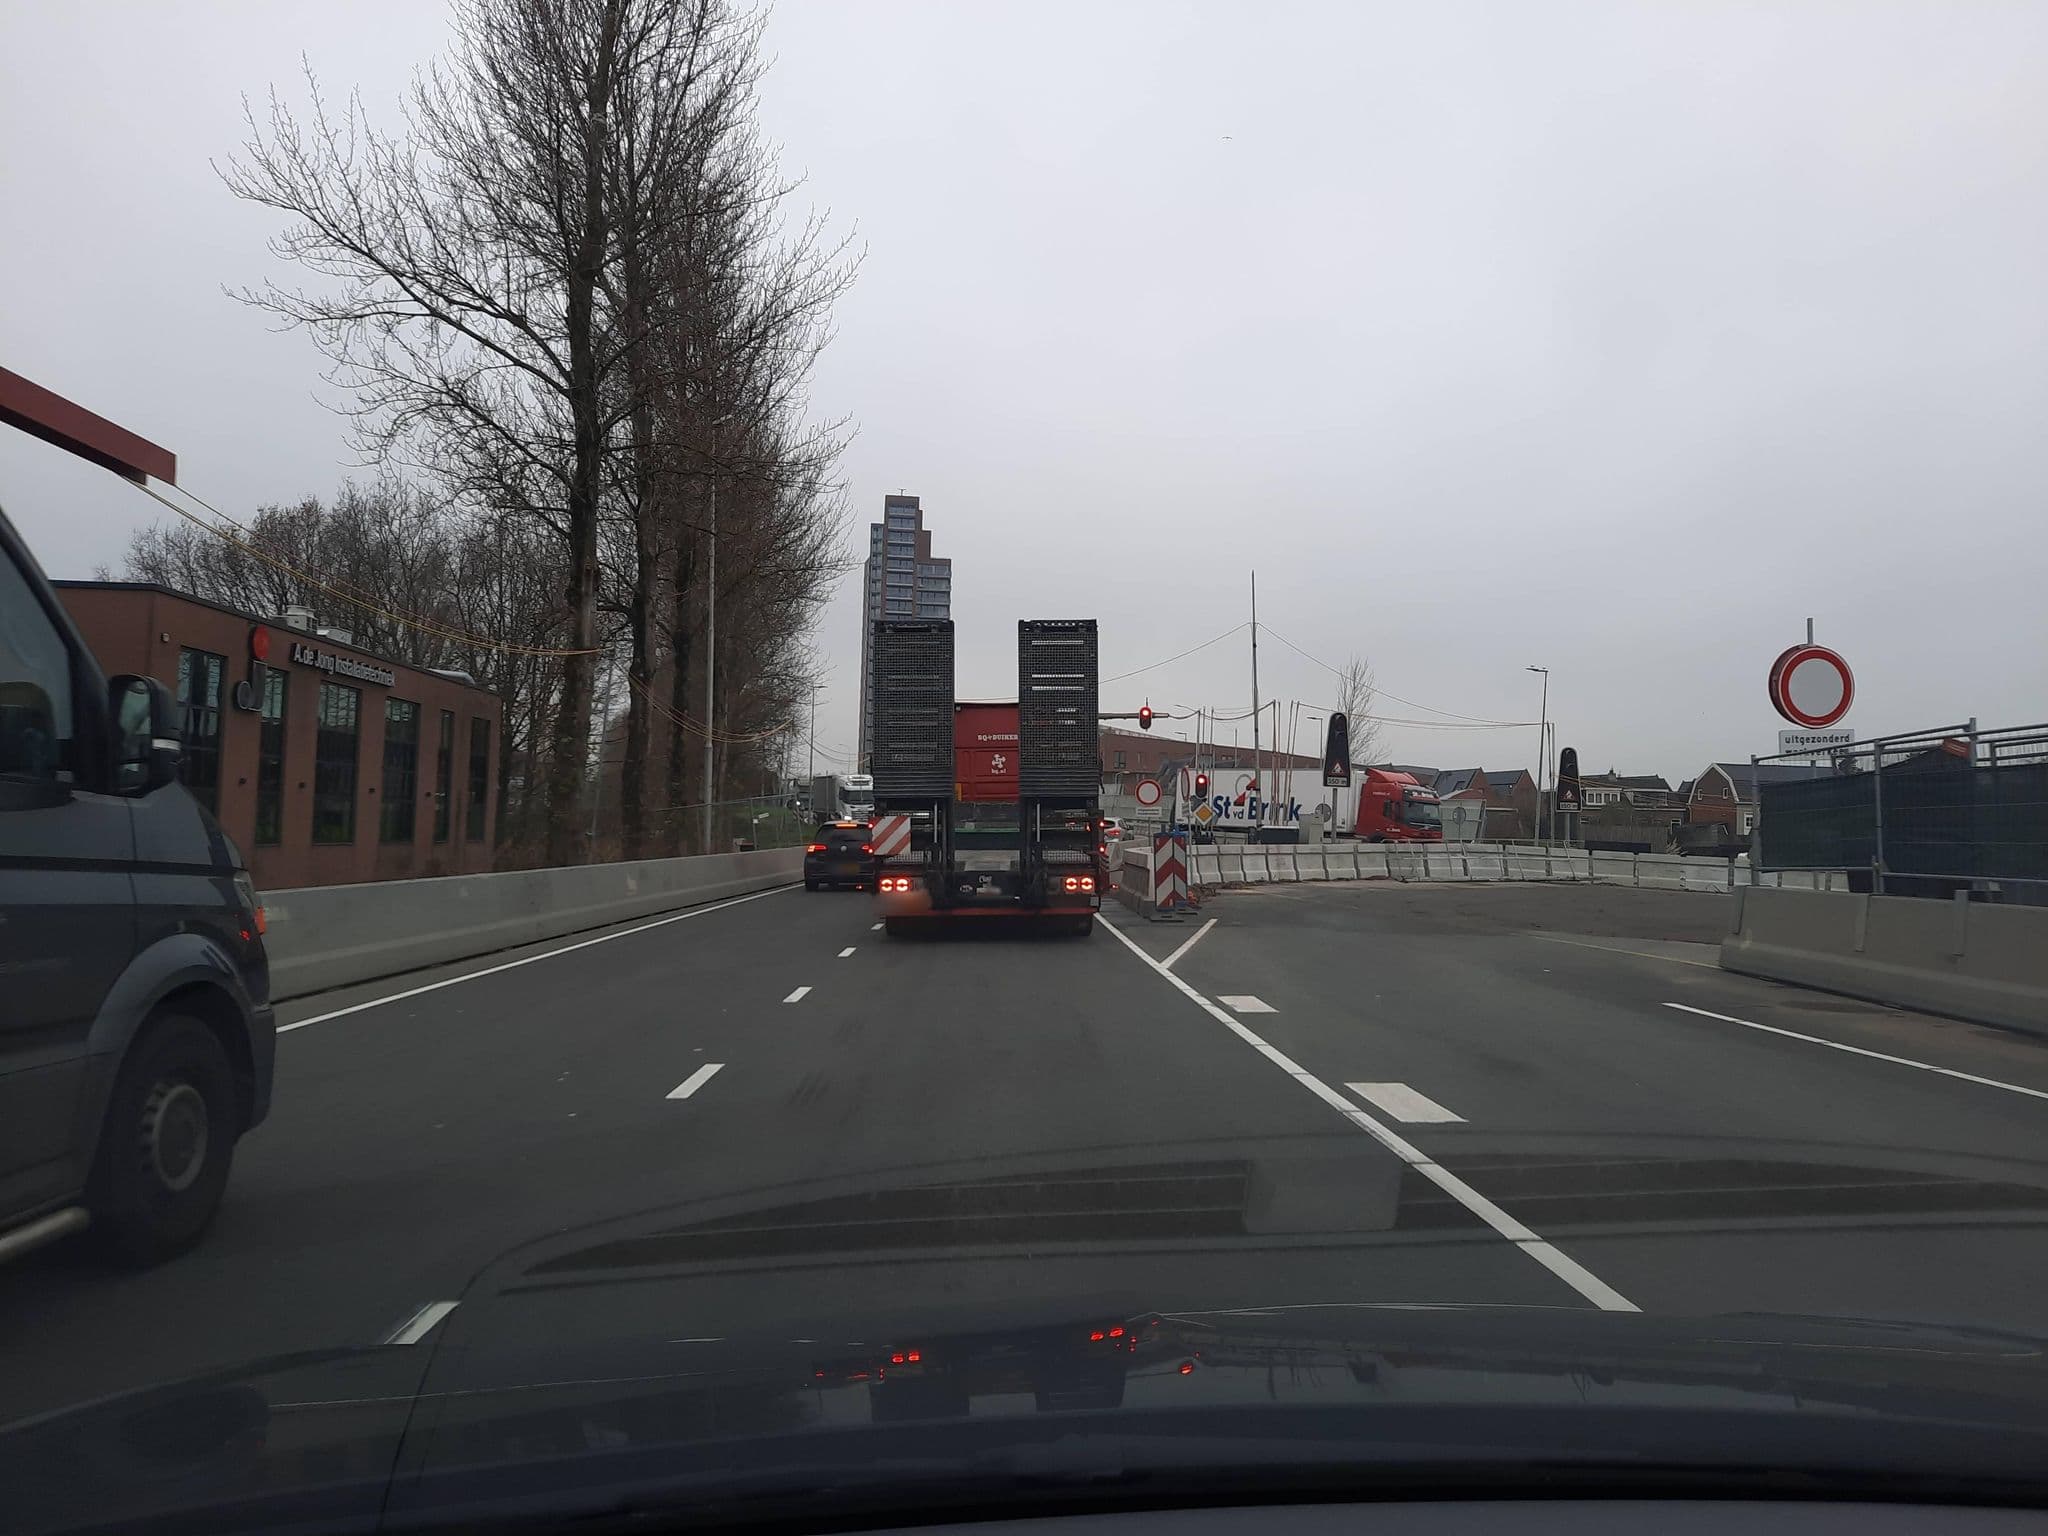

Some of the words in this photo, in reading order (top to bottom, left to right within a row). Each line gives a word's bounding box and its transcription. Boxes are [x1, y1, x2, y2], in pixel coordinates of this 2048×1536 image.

[315, 650, 334, 675] Jong
[1784, 733, 1850, 745] uitgezonderd
[1213, 795, 1232, 819] St
